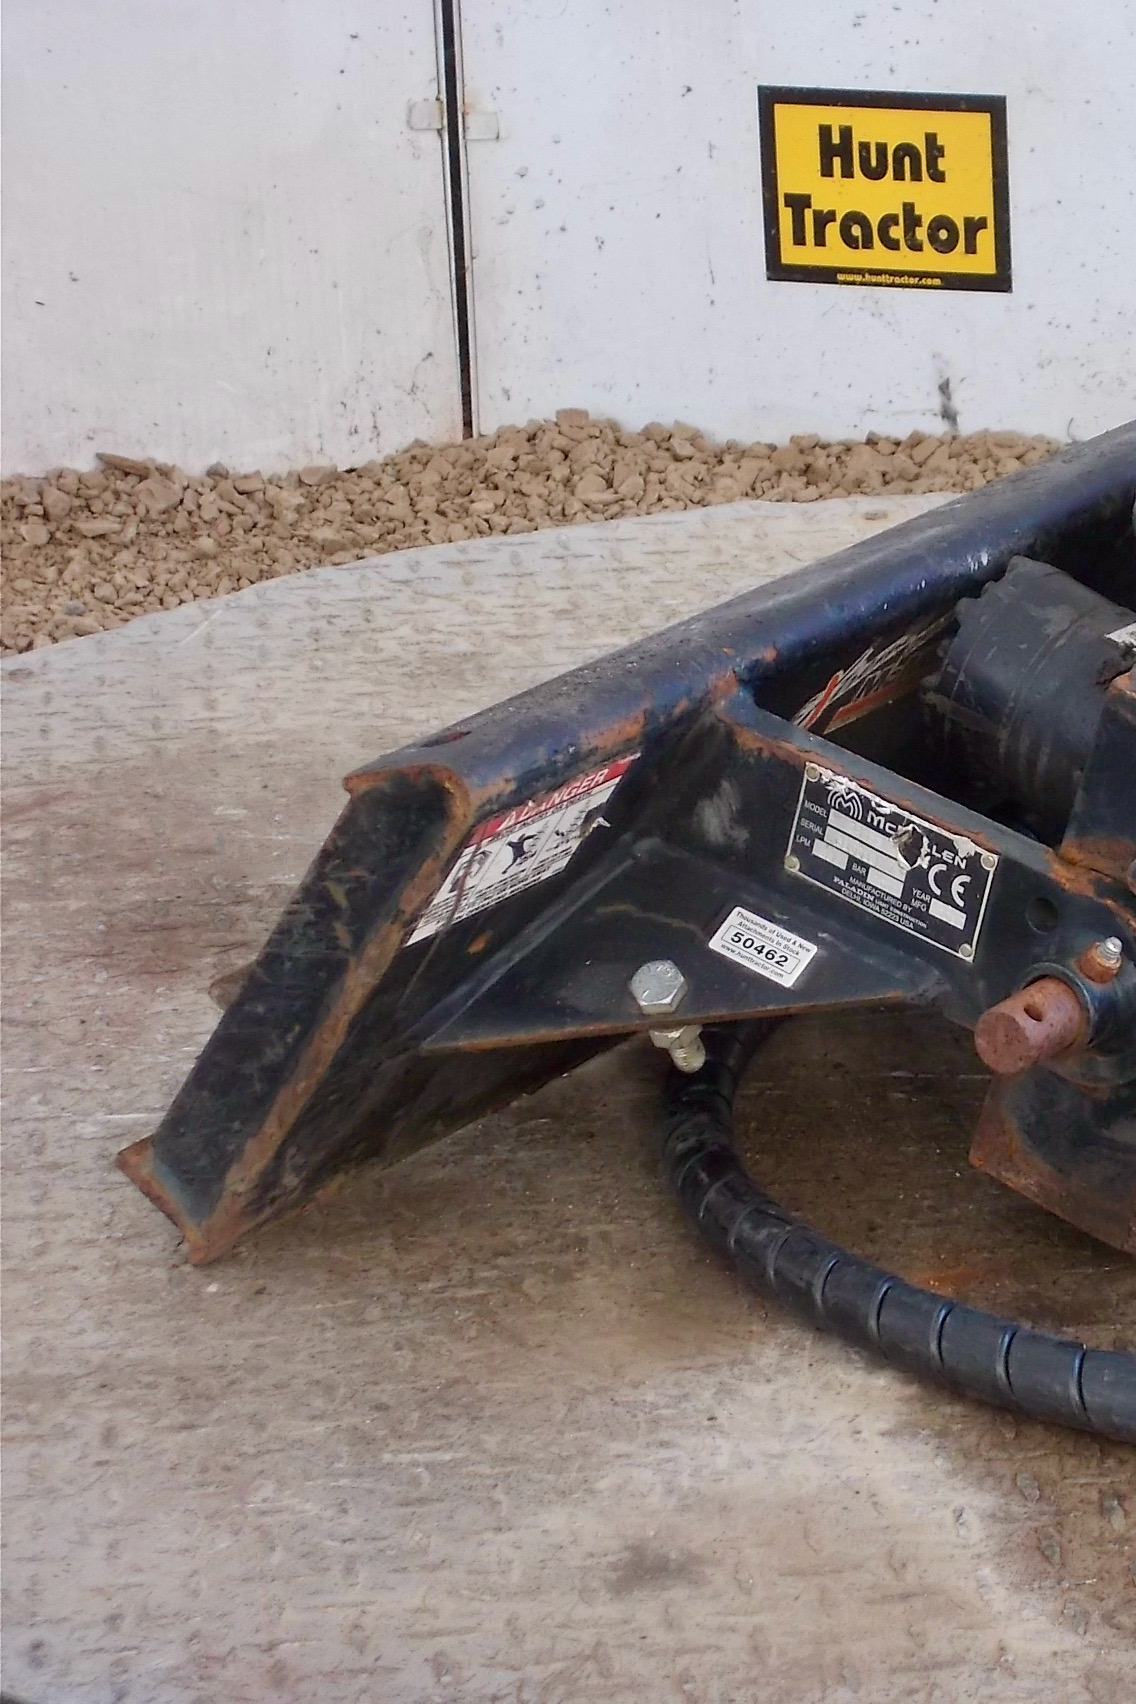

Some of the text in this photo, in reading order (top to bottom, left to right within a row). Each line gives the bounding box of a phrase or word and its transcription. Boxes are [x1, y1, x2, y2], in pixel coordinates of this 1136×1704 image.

[818, 123, 946, 183] Hunt
[783, 192, 988, 255] Tractor
[836, 272, 942, 286] www.hunttractor.com
[804, 799, 828, 818] MODEL
[796, 834, 811, 847] LPM
[800, 818, 824, 836] SERIAL
[851, 863, 867, 877] BAR
[833, 875, 875, 901] PALADIN
[849, 876, 913, 913] MANUFACTURED BY
[912, 887, 932, 903] YEAR
[928, 863, 972, 908] CE
[863, 899, 880, 913] IOWA
[900, 917, 914, 929] USA
[911, 898, 927, 912] MFG
[736, 911, 768, 931] Thousands
[776, 930, 792, 944] Used
[797, 942, 812, 953] New
[737, 921, 776, 945] Attachments
[782, 944, 800, 956] Stock
[720, 944, 784, 979] www.hunttractor.com
[730, 931, 789, 968] 50462
